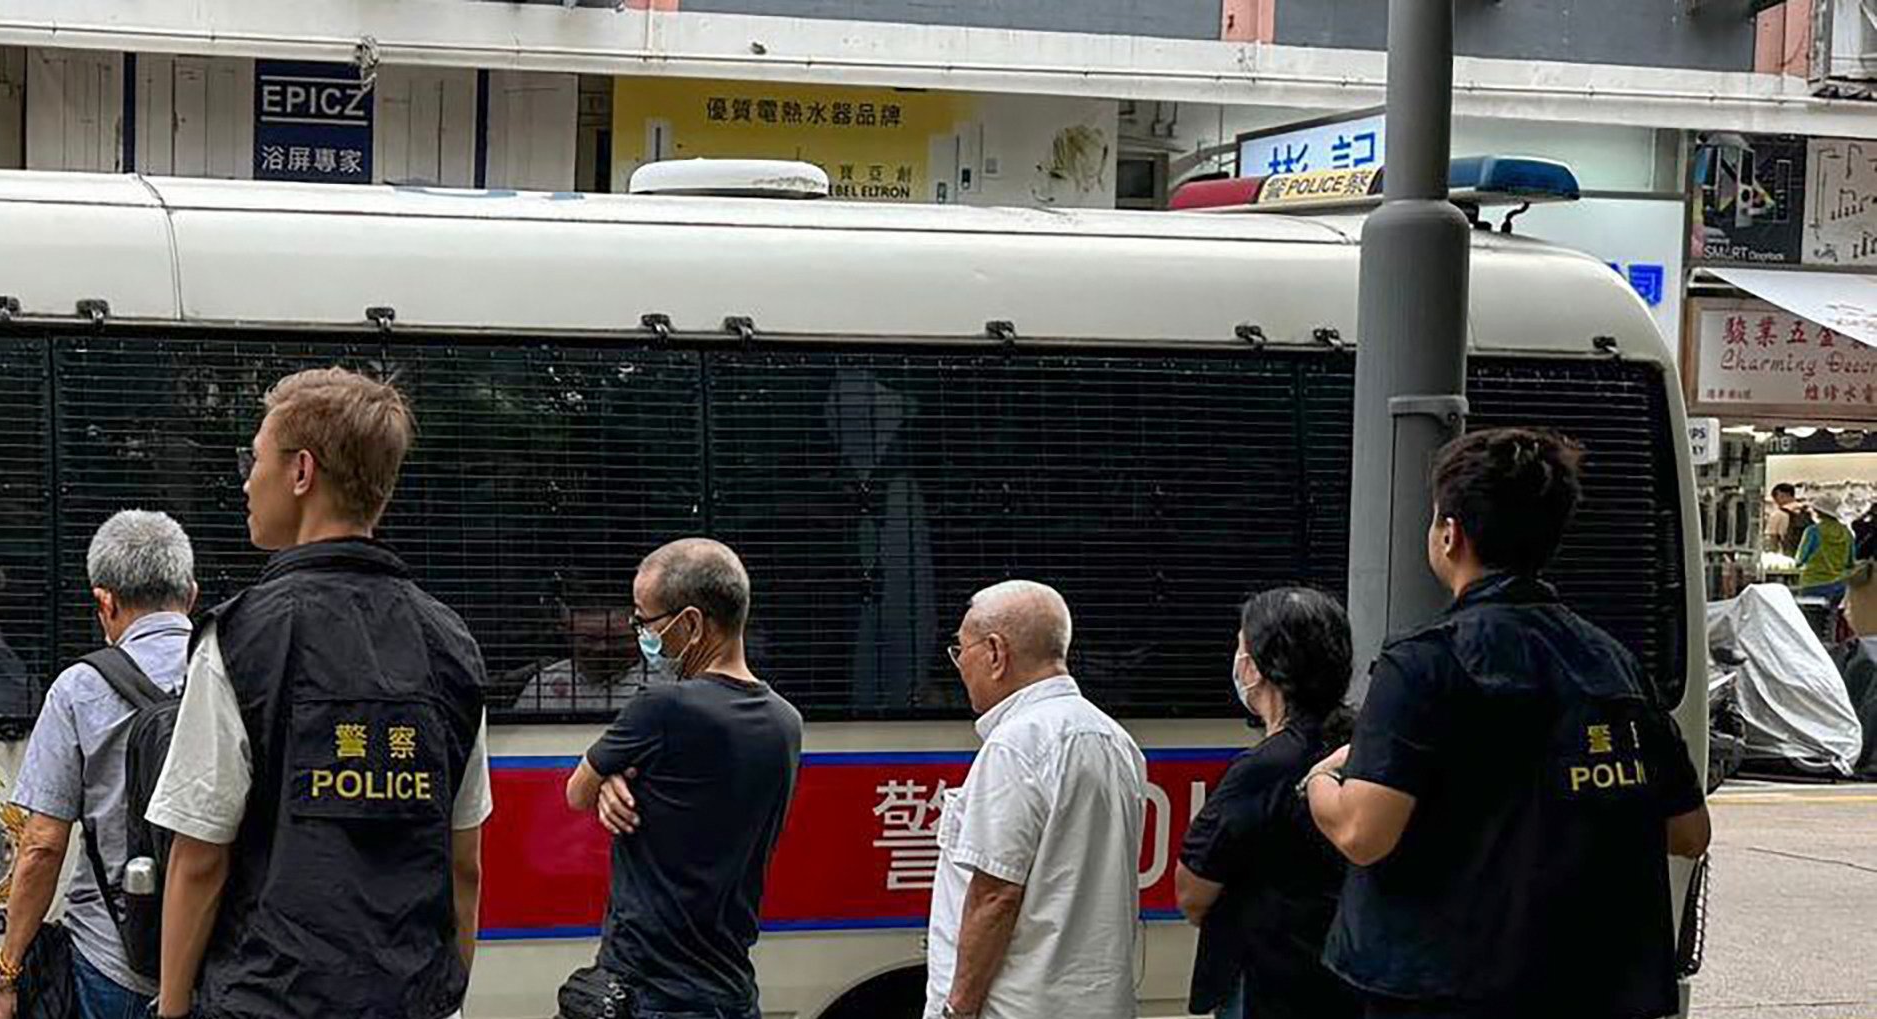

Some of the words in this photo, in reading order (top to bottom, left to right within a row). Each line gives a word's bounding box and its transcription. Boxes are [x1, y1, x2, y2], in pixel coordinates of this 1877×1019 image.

[262, 85, 365, 116] EPICZ
[706, 96, 902, 128] 優質電熱水器品牌
[261, 145, 363, 174] 浴屏專家
[1284, 175, 1346, 196] POLICE
[1720, 348, 1818, 382] Charming
[335, 723, 417, 759] 警察
[311, 769, 432, 800] POLICE
